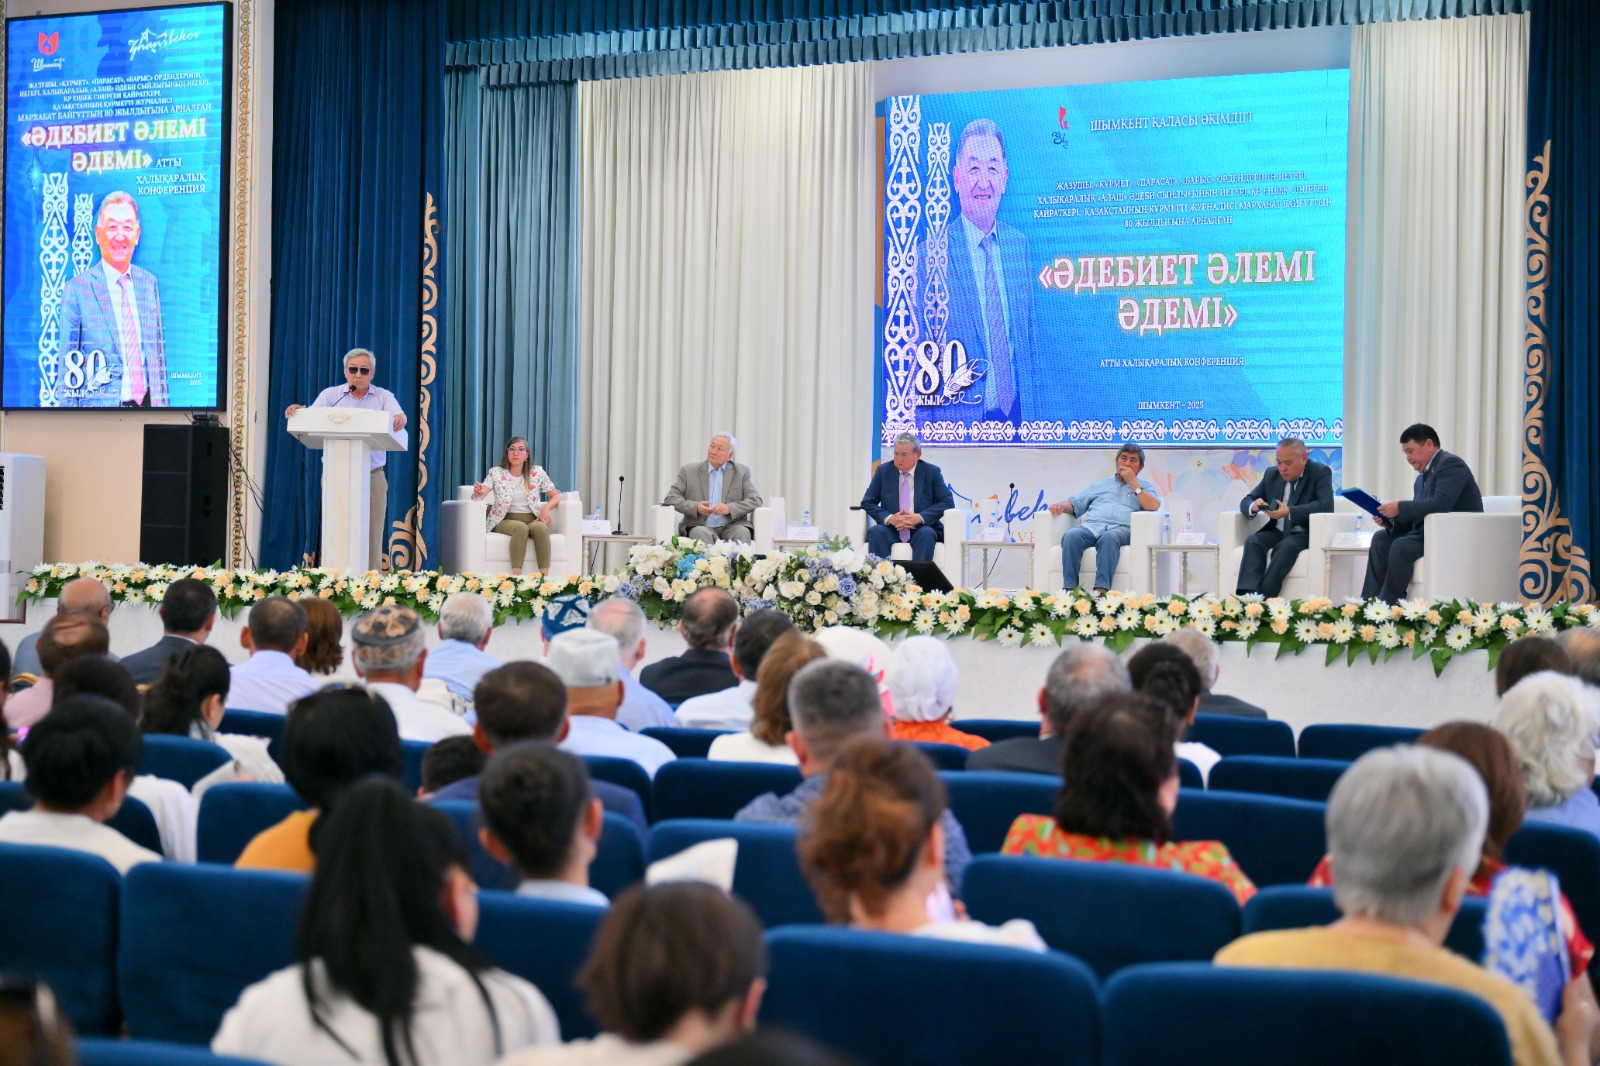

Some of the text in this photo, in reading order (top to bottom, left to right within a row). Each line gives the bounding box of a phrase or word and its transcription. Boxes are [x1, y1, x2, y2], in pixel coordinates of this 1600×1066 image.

[104, 109, 114, 117] 80
[1090, 117, 1149, 132] ШЫМКЕНТ
[1151, 114, 1199, 129] ҚАЛАСЫ
[20, 117, 207, 149] «ӘДЕБИЕТ ӘЛЕМІ
[72, 149, 182, 174] ӘДЕМІ» АТТЫ
[137, 184, 206, 195] КОНФЕРЕНЦИЯ
[1123, 219, 1134, 228] 80
[1038, 250, 1316, 294] «ӘДЕБИЕТ ӘЛЕМІ
[1118, 296, 1239, 336] ӘДЕМІ»
[64, 349, 107, 389] 80
[916, 340, 967, 394] 80
[1099, 358, 1120, 367] АТТЫ
[1184, 356, 1244, 367] КОНФЕРЕНЦИЯ
[1137, 401, 1181, 410] ШЫМКЕНТ
[1187, 400, 1204, 410] 2025
